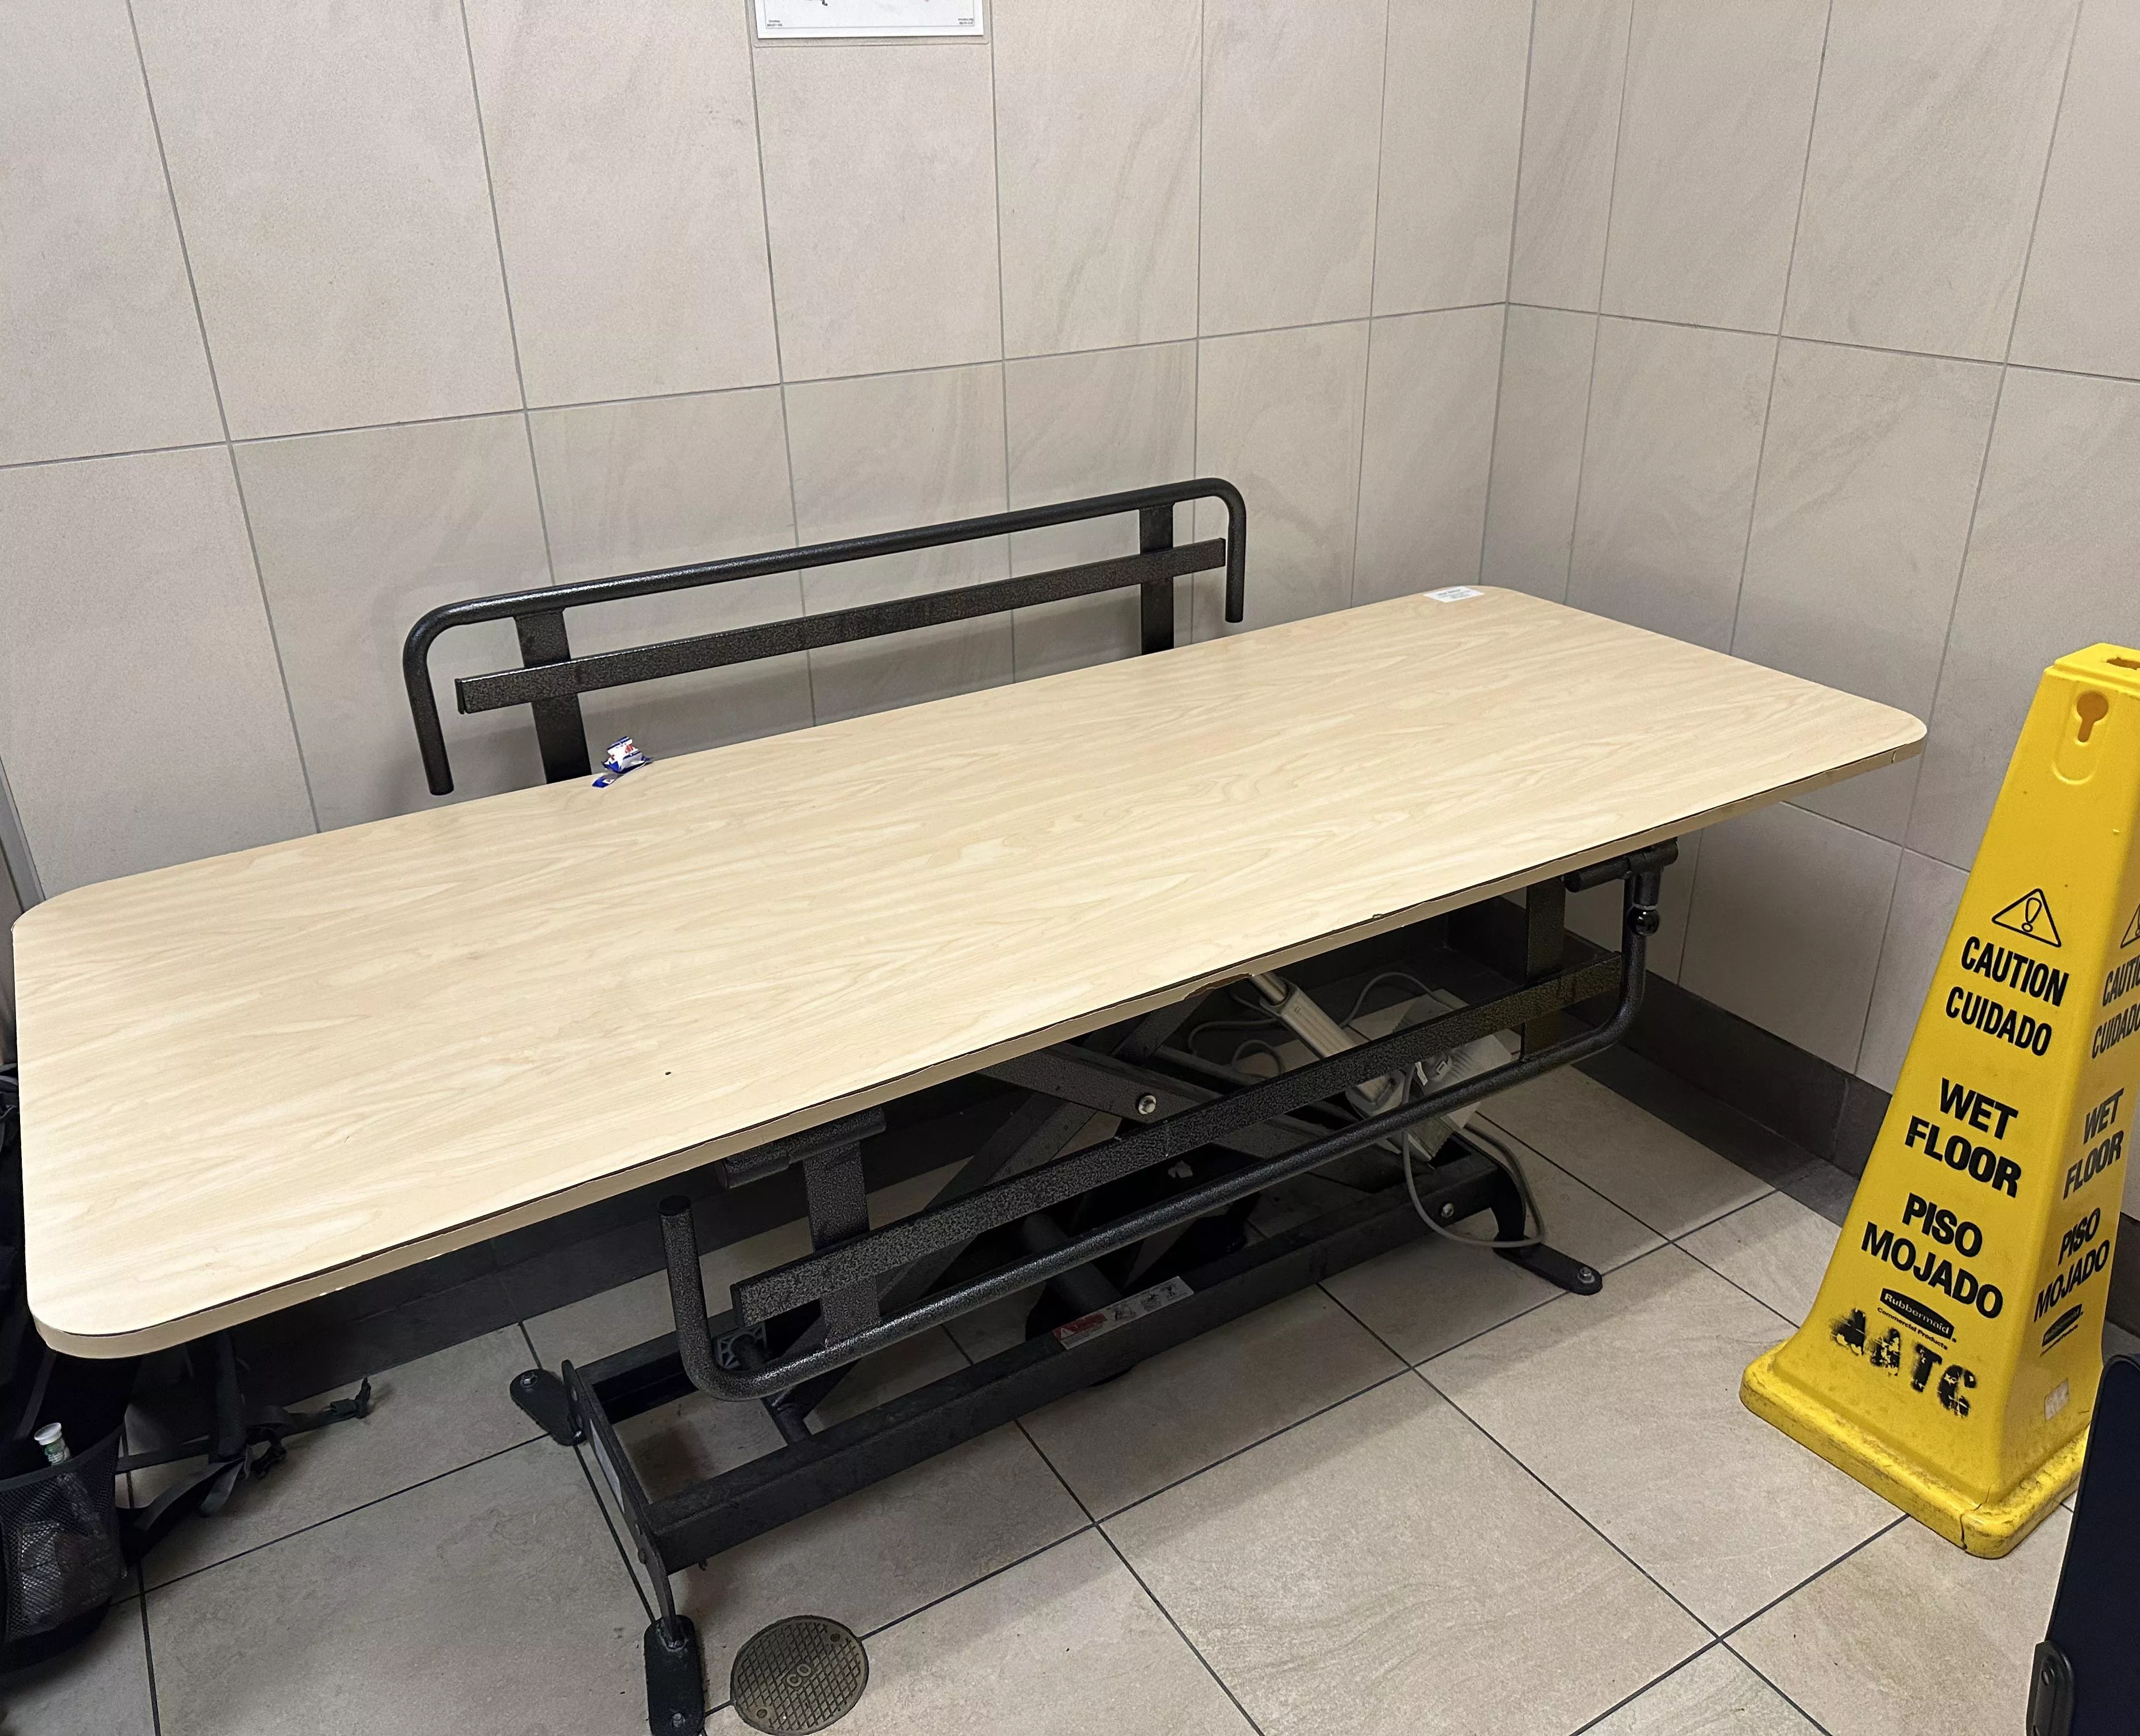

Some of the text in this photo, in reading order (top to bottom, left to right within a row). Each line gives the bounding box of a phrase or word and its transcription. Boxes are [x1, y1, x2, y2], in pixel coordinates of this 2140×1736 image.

[1961, 936, 2069, 1007] CAUTION
[1945, 986, 2052, 1056] CUIDADO
[1940, 1077, 2019, 1140] WET
[2084, 1087, 2124, 1145] WET
[1905, 1115, 2022, 1198] FLOOR
[2062, 1130, 2124, 1200] FLOOR
[1902, 1192, 1983, 1258] PISO
[2057, 1207, 2101, 1267] PISO
[1861, 1221, 2003, 1319] MOJADO
[2033, 1239, 2110, 1323] MOJADO
[1877, 1307, 1948, 1351] Commercial Products
[1884, 1293, 1950, 1335] Rubbermaid
[786, 1664, 811, 1687] CO
